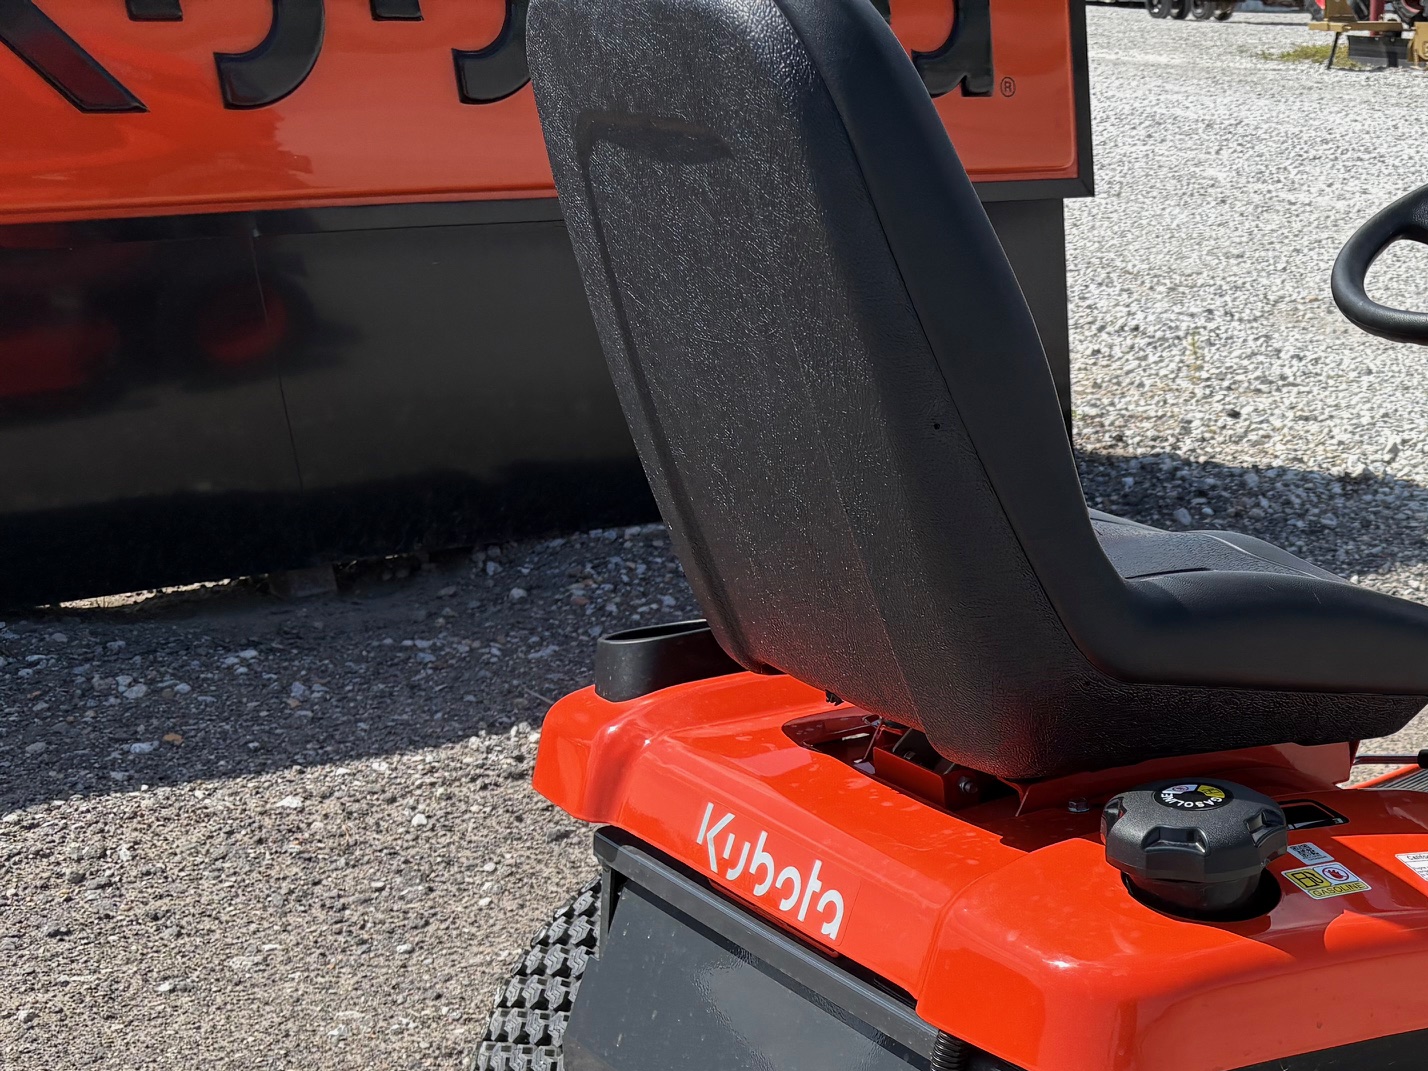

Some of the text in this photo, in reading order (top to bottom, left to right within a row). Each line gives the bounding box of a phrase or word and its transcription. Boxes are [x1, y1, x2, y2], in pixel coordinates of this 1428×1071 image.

[1161, 793, 1223, 808] GASOLINE
[696, 802, 845, 940] Kubota
[1312, 882, 1365, 897] GASOLINE
